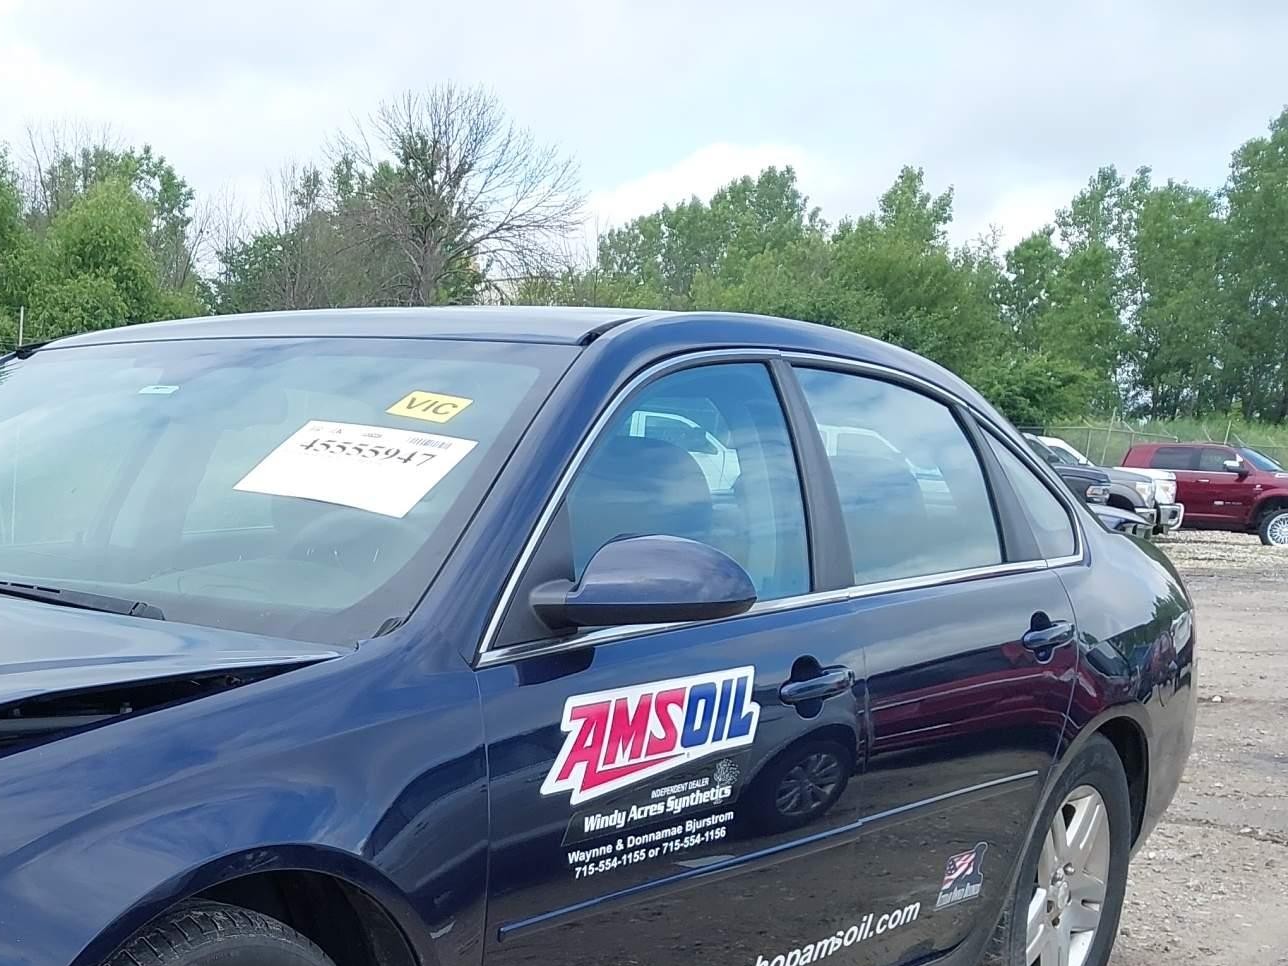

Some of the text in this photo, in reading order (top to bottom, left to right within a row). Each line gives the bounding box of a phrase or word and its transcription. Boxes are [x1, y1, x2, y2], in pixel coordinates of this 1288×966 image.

[406, 397, 459, 415] VIC
[300, 438, 438, 466] 45555947
[556, 675, 753, 792] AMSOIL
[583, 785, 732, 833] Windy Acres Synthetics
[650, 777, 710, 799] INDEPENDENT DEALER
[568, 811, 734, 864] Waynne & Donnamae Bjurstrom
[574, 826, 727, 879] 715-554-1155 or 715-554-1156
